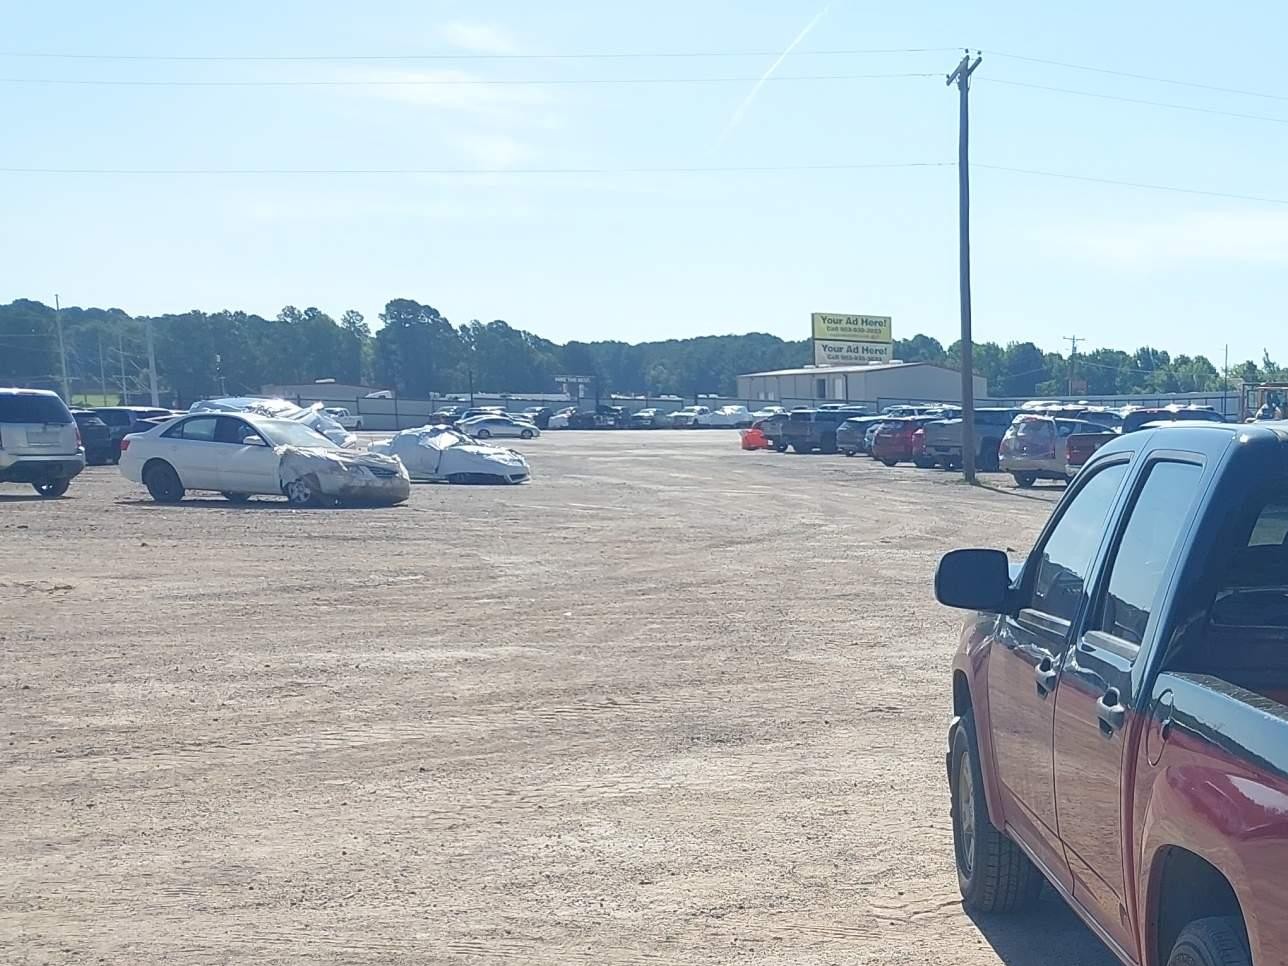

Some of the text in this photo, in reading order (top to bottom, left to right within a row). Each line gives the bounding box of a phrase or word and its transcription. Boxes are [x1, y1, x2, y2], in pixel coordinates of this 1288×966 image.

[820, 316, 887, 327] Your Ad Here!
[822, 344, 887, 355] Your Ad Here!
